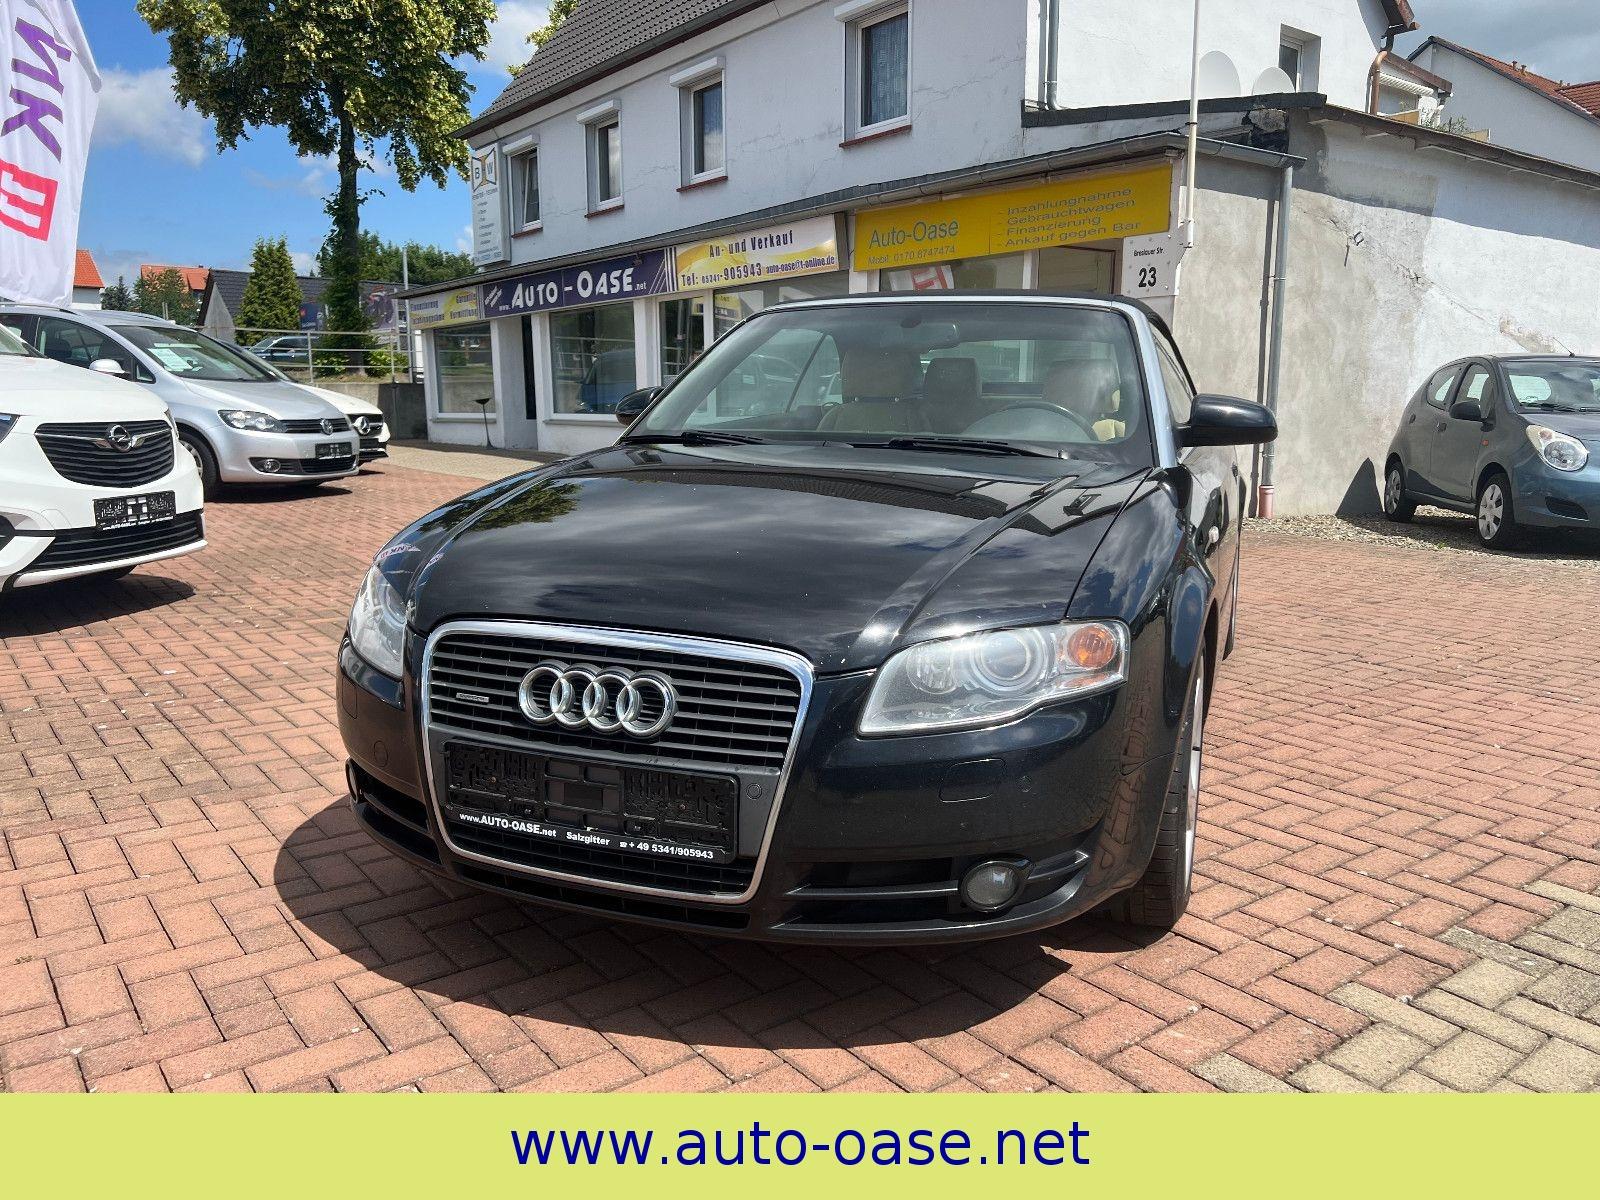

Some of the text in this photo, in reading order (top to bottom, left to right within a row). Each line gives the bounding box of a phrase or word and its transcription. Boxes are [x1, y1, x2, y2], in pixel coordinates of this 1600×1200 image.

[1007, 200, 1136, 226] Gebrauchtwagen
[1008, 188, 1132, 216] Inzahlungnahme
[868, 220, 959, 249] Auto-Oase
[1006, 222, 1142, 247] Ankauf gegen Bar
[1007, 216, 1102, 236] Finanzierung
[728, 239, 747, 254] und
[750, 230, 793, 251] Verkauf
[681, 273, 699, 287] Tel:
[1138, 266, 1157, 288] 23
[459, 813, 557, 838] www.AUTO-OASE.net
[566, 831, 611, 846] Salzgitter
[637, 842, 650, 851] 49
[651, 844, 714, 859] 5341/905943
